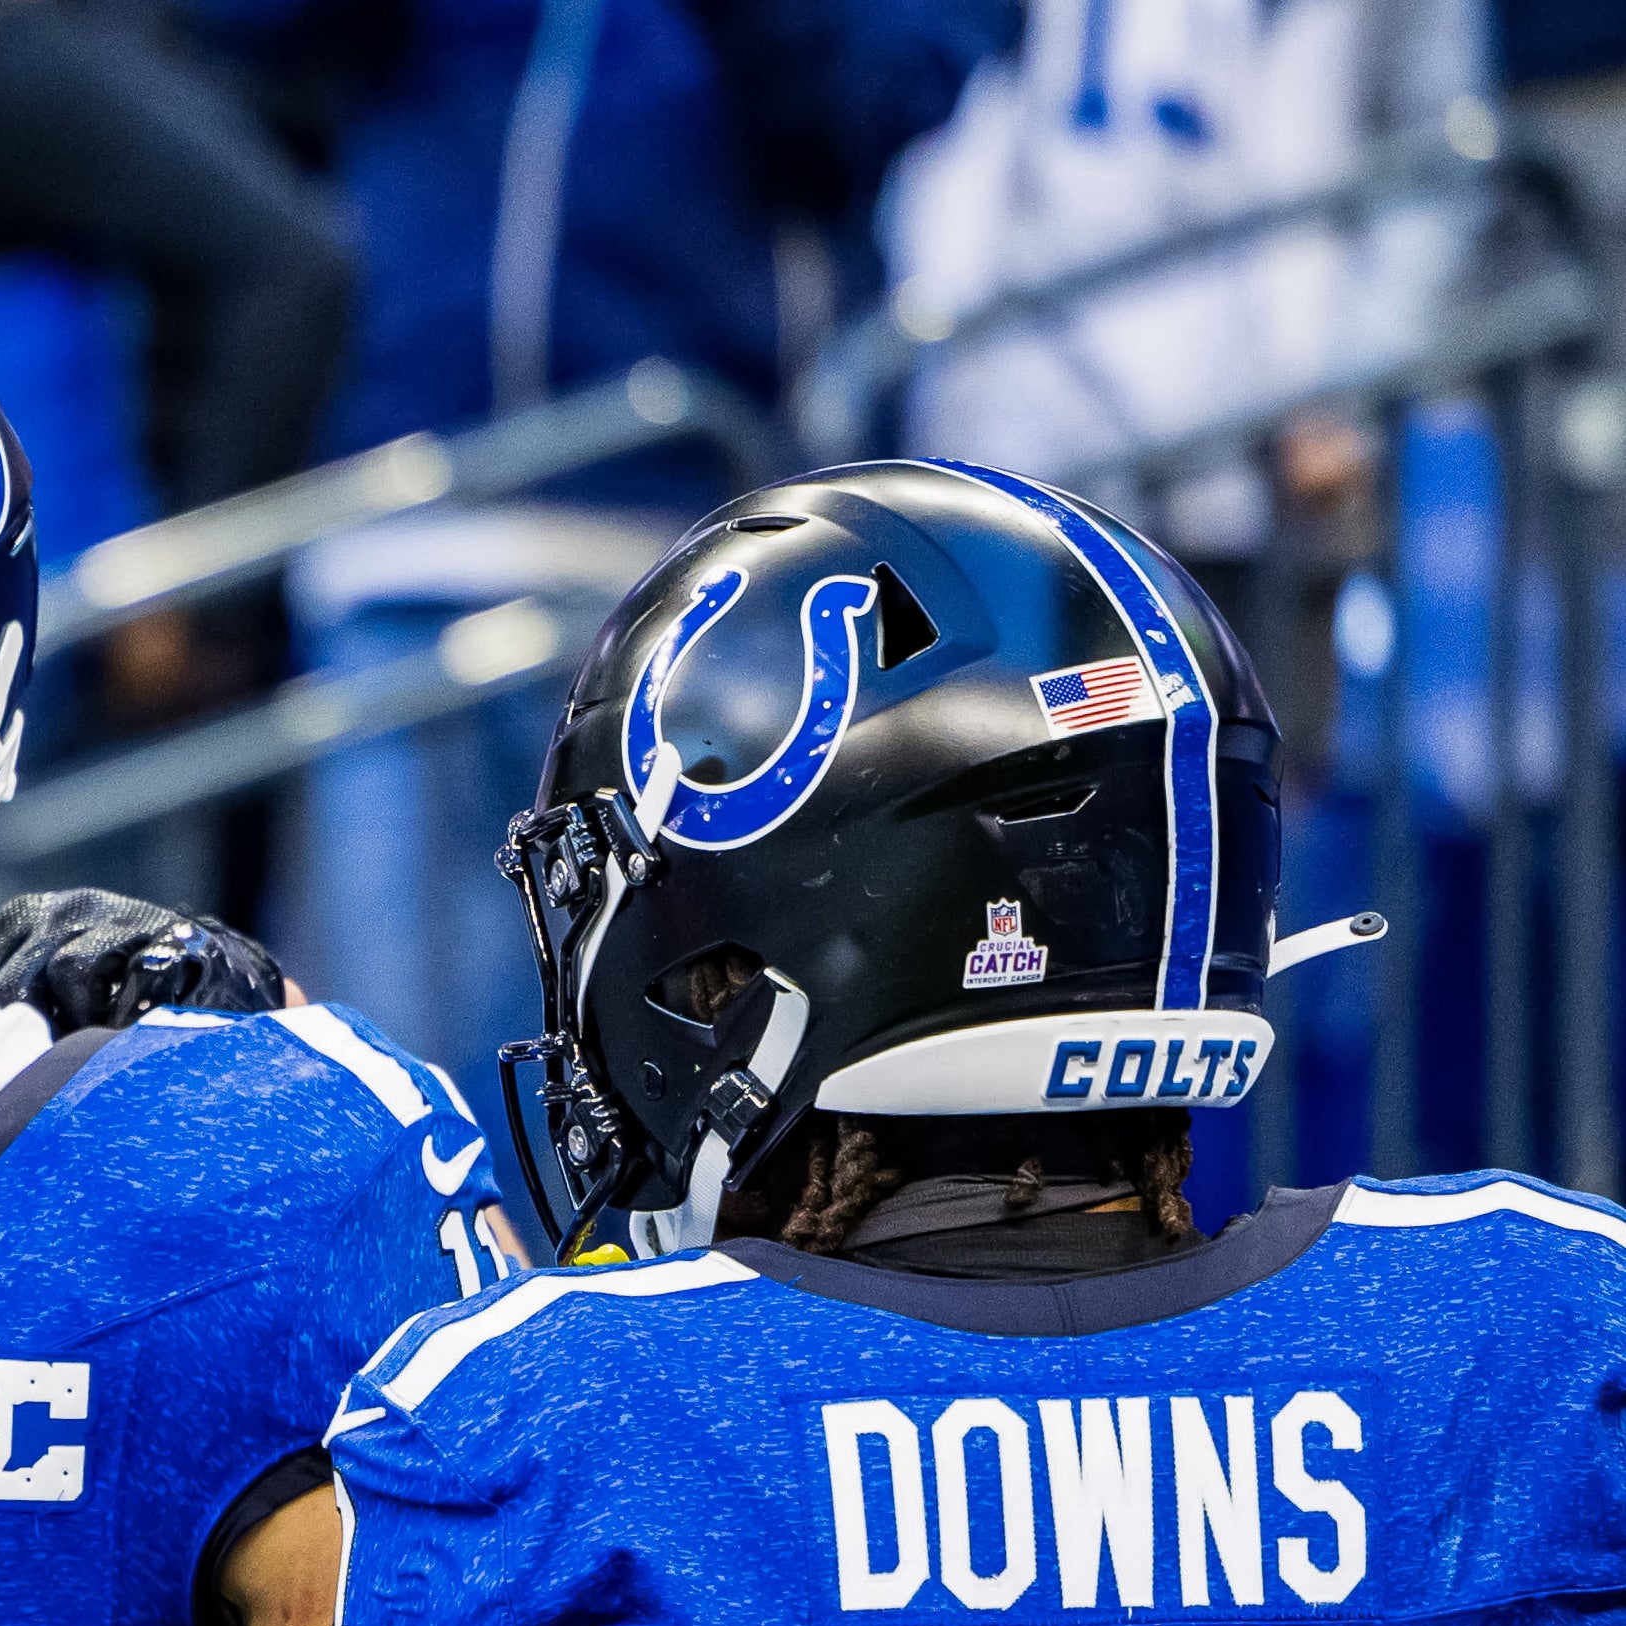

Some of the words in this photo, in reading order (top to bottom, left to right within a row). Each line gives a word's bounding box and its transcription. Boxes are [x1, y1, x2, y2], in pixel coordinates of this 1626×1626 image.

[993, 917, 1018, 933] NFL
[980, 940, 1033, 953] CRUCIAL
[969, 949, 1044, 975] CATCH
[1044, 1039, 1257, 1098] COLTS
[821, 1388, 1368, 1612] DOWNS
